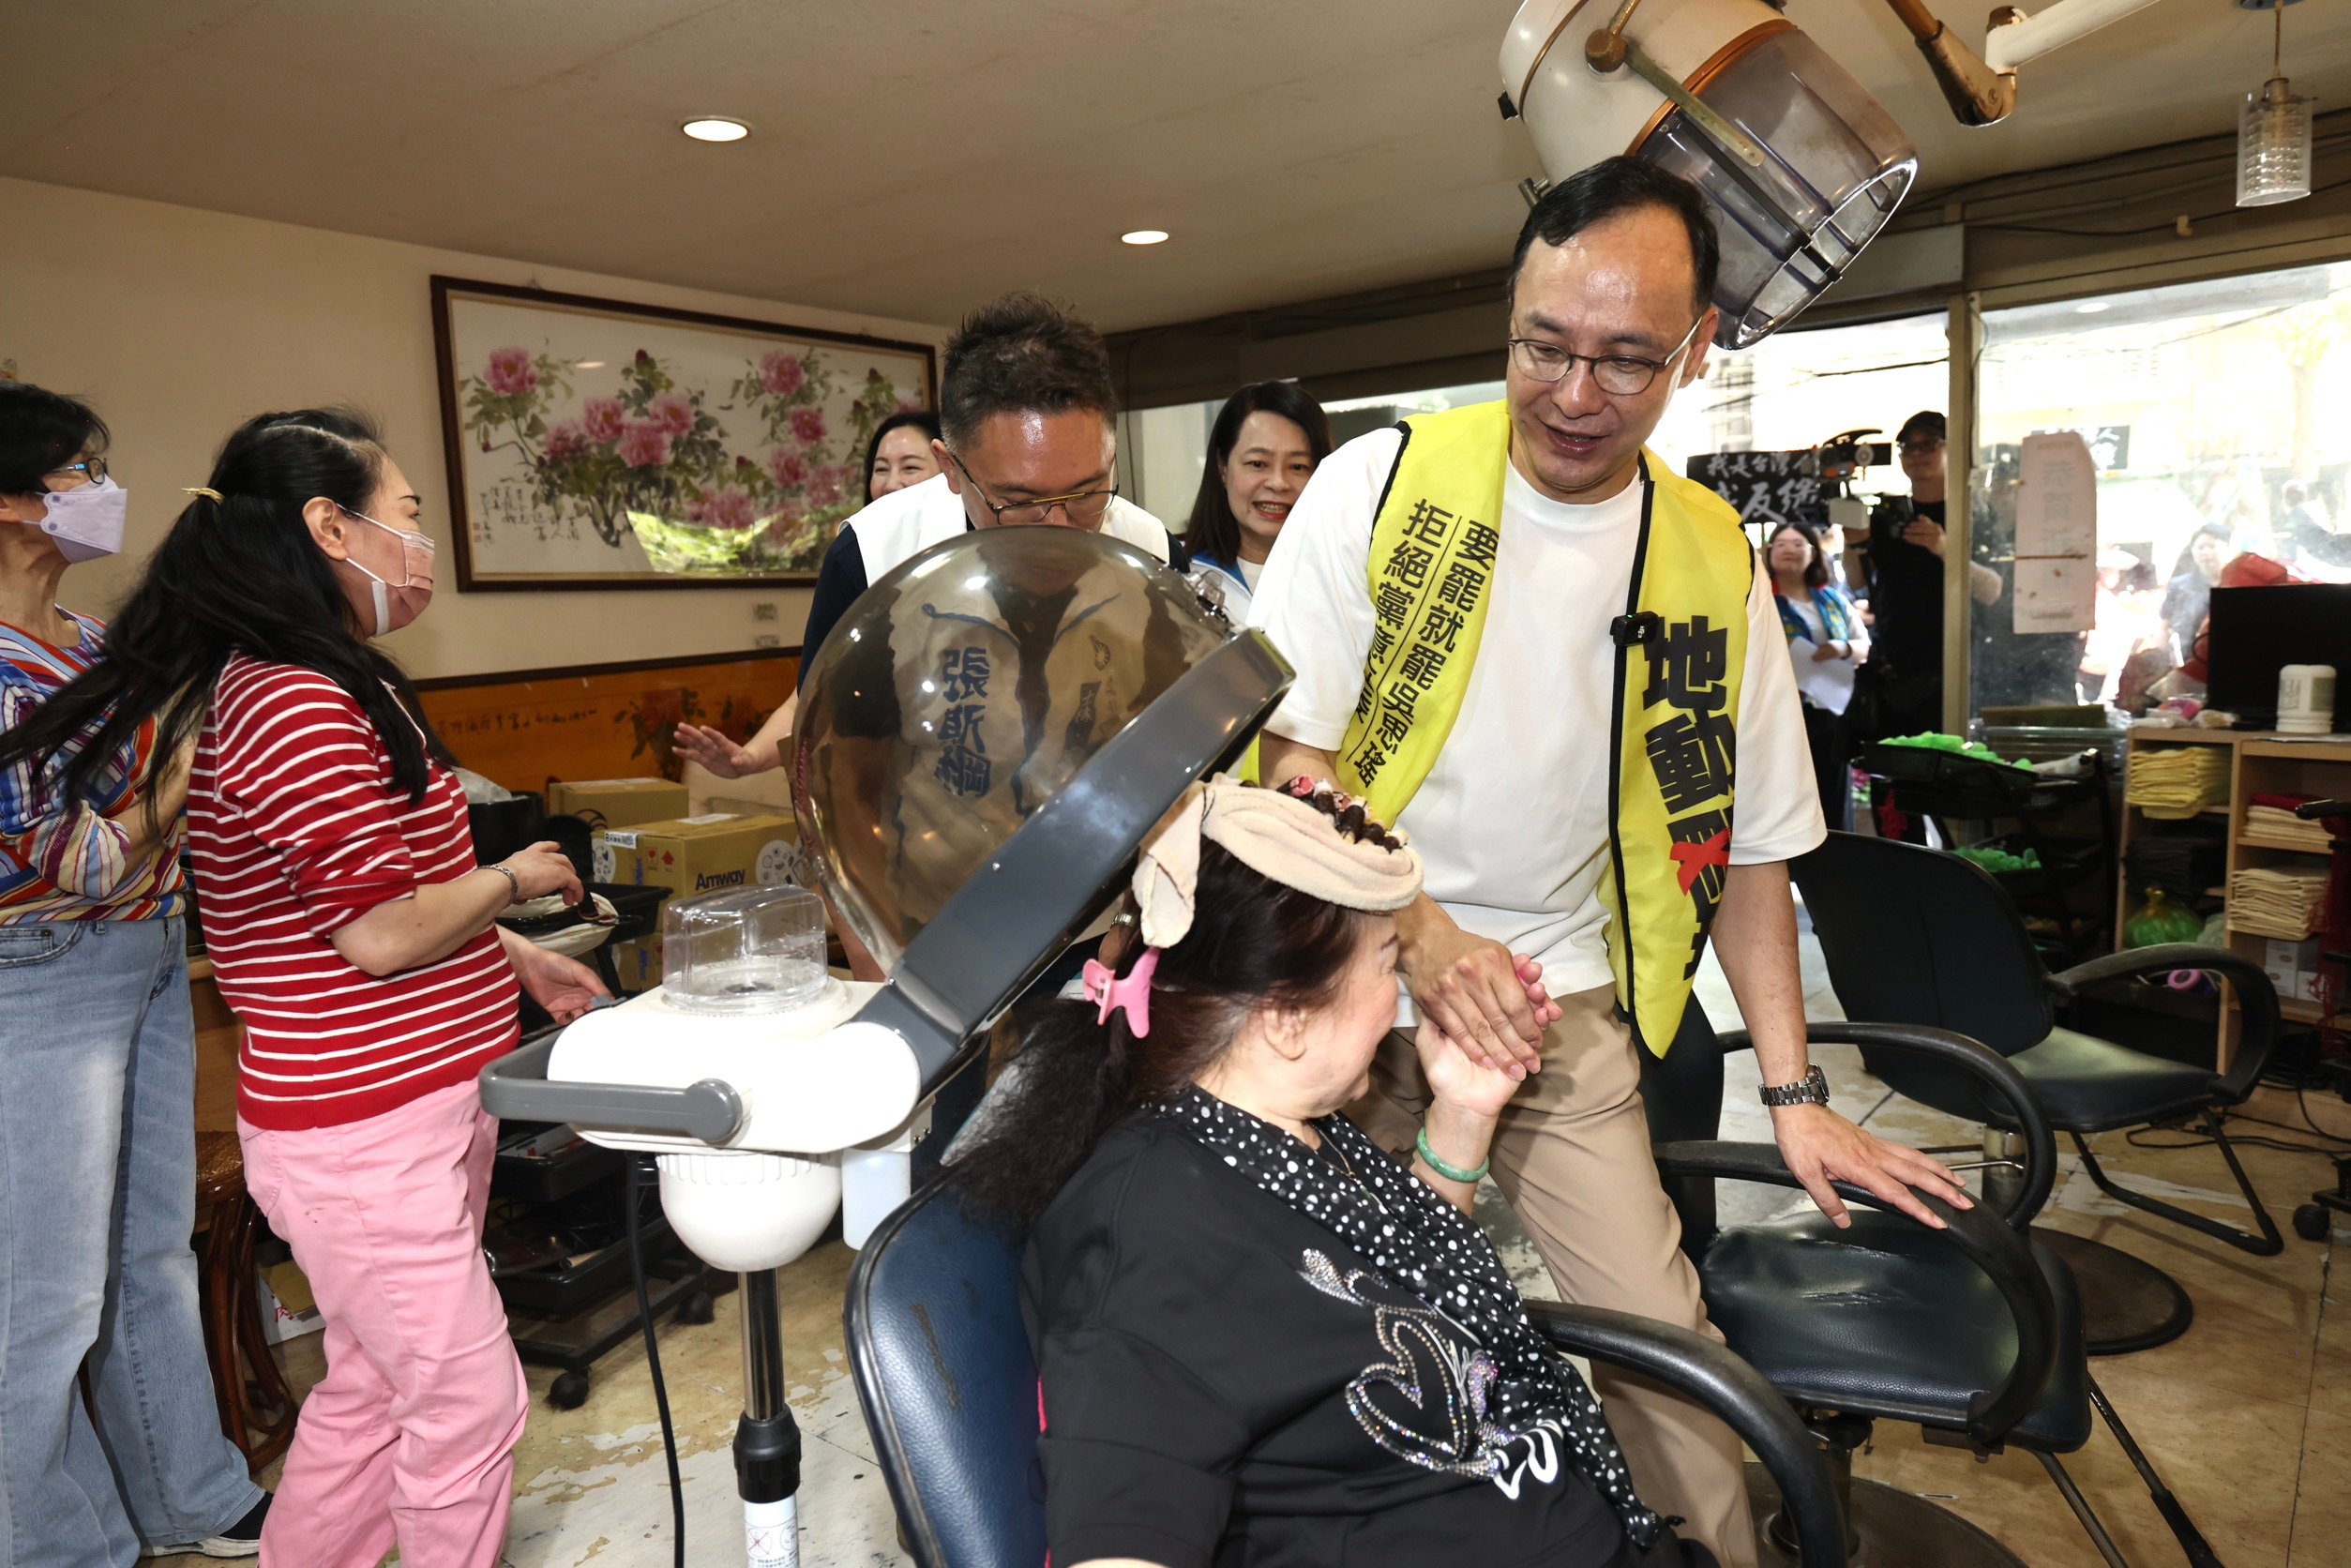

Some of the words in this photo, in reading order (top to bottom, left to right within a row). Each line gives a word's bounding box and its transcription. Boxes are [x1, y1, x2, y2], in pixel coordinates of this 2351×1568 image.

[934, 646, 991, 798] 張斯綱
[1354, 519, 1500, 789] 要罷就罷吳思瑤
[695, 869, 746, 891] Amway
